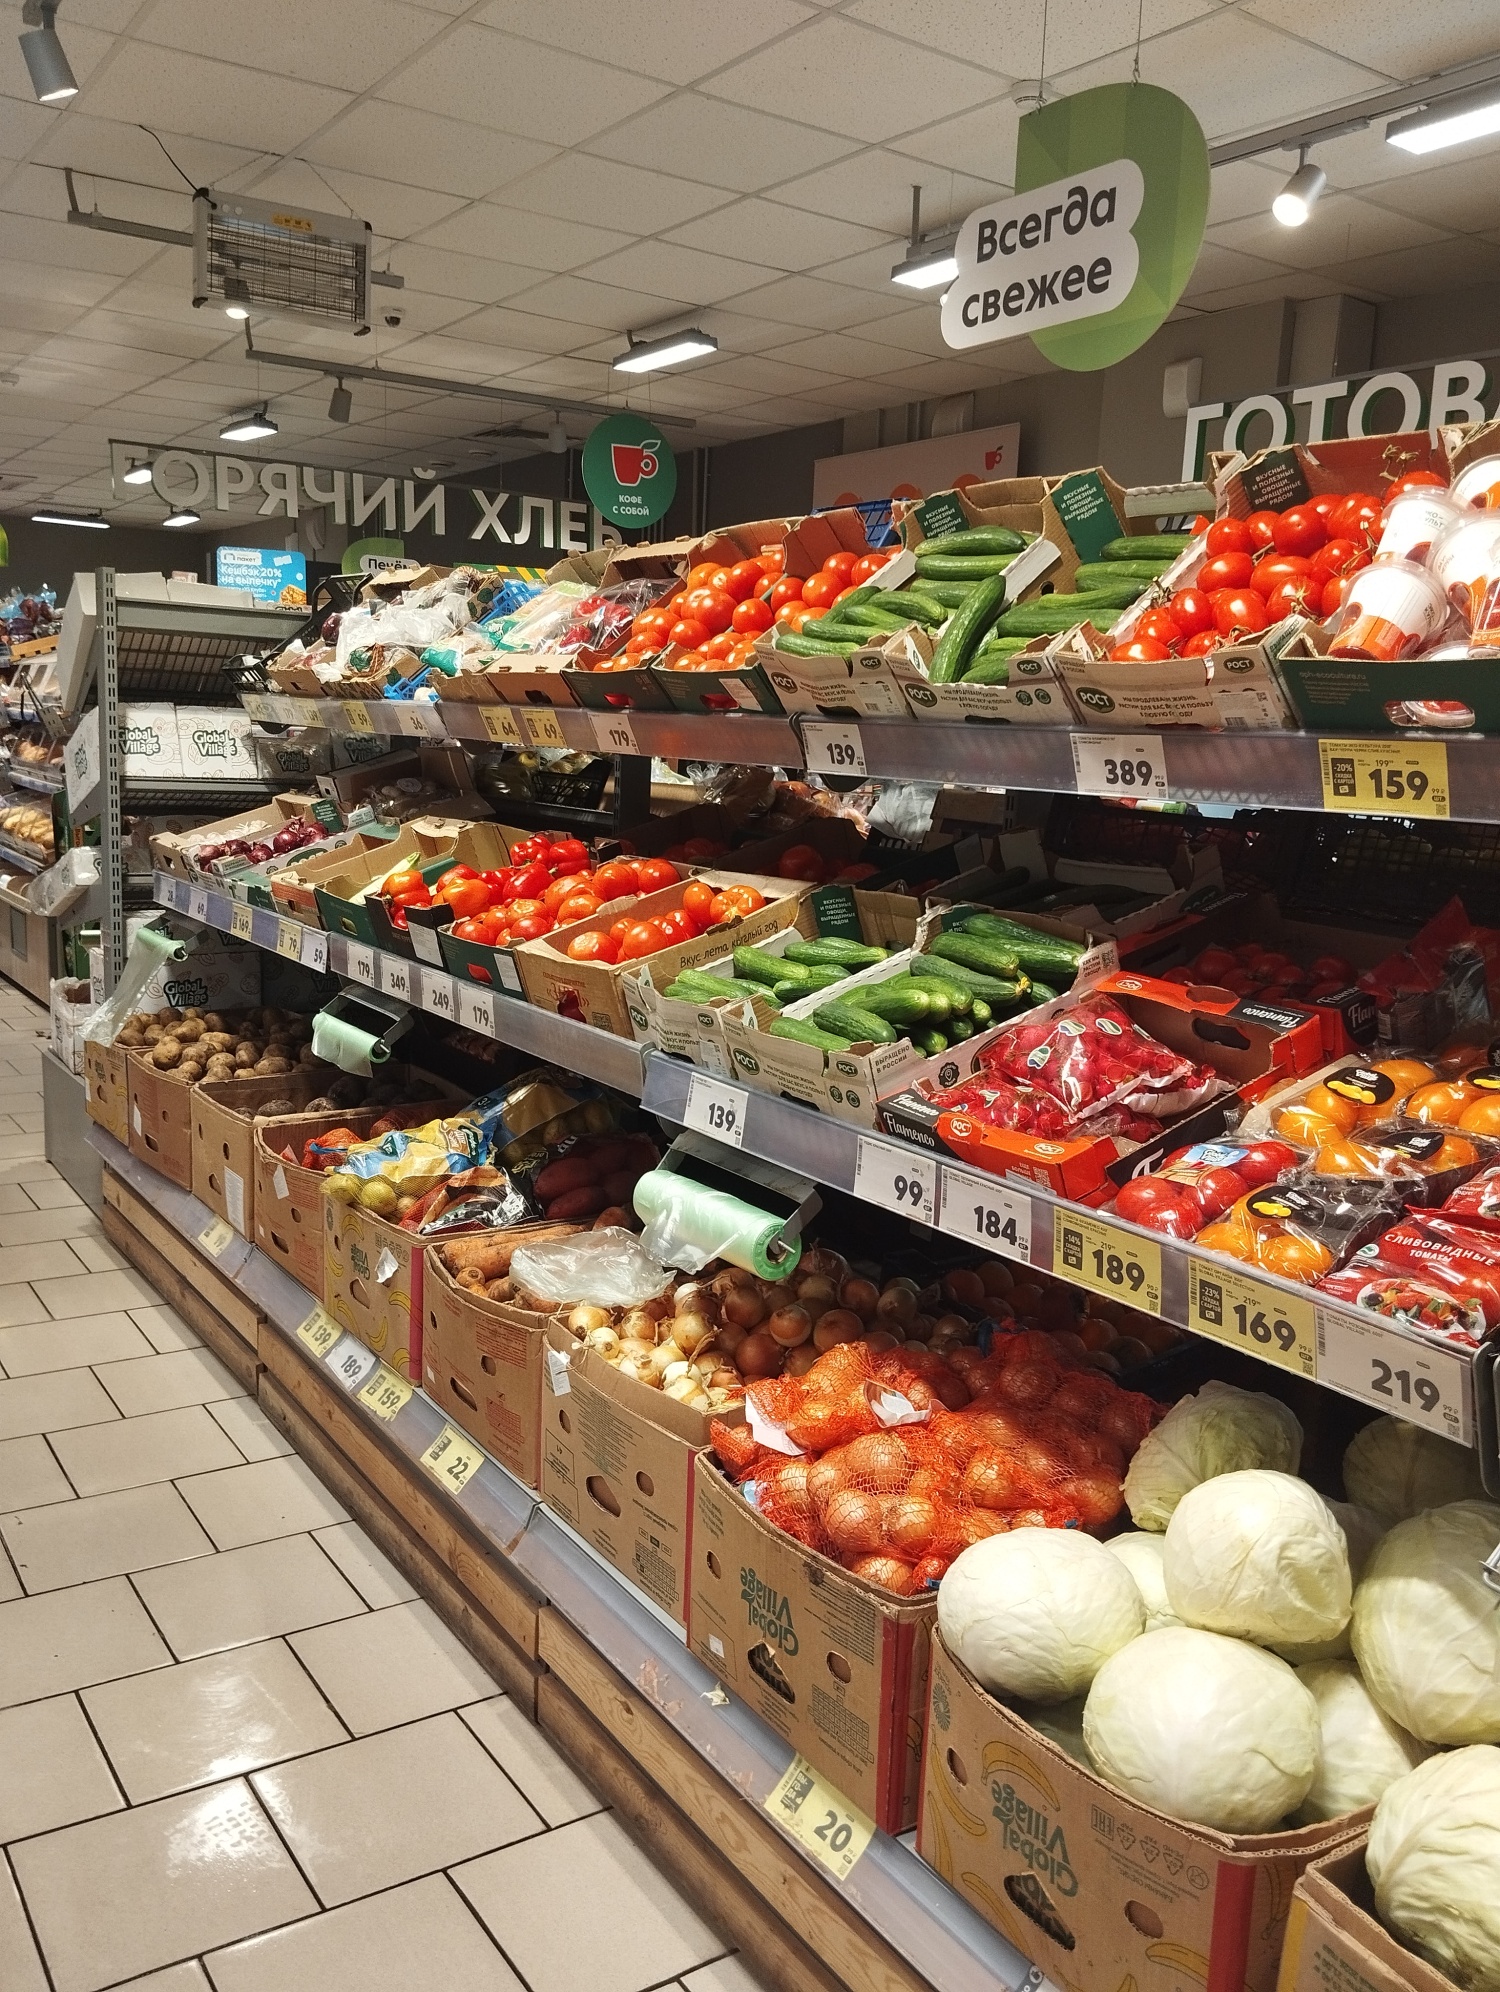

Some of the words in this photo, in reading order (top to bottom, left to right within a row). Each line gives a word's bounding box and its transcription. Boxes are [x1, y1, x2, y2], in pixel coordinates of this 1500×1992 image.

[976, 185, 1117, 264] Всегда
[961, 256, 1112, 328] свежее
[1180, 359, 1500, 483] ГОТОВ
[618, 494, 643, 504] КОФЕ
[612, 505, 619, 514] С
[620, 505, 650, 516] СОБОЙ
[221, 564, 260, 576] Кешбэк
[260, 566, 283, 578] 20%
[862, 658, 880, 667] РОСТ
[1020, 662, 1040, 672] РОСТ
[1226, 659, 1251, 670] РОСТ
[773, 675, 795, 688] РОСТ
[908, 688, 933, 701] РОСТ
[1079, 691, 1110, 707] РОСТ
[358, 712, 368, 726] 59
[410, 716, 423, 731] 36
[118, 727, 159, 744] Global
[501, 721, 516, 737] 64
[543, 723, 557, 740] 69
[608, 729, 631, 747] 179
[119, 740, 161, 755] Village
[193, 730, 236, 747] Global
[197, 742, 237, 757] Village
[826, 742, 855, 765] 139
[1104, 759, 1152, 786] 389
[1333, 764, 1353, 772] -20%
[1368, 768, 1429, 801] 159
[196, 902, 205, 915] 69
[238, 916, 249, 932] 169
[288, 936, 297, 953] 79
[680, 952, 702, 968] Вкус
[703, 944, 730, 959] лета
[764, 920, 779, 933] год
[313, 947, 323, 964] 59
[357, 959, 371, 979] 179
[165, 978, 208, 996] Global
[390, 972, 406, 992] 349
[168, 992, 209, 1007] Village
[432, 989, 450, 1011] 249
[472, 1005, 490, 1027] 179
[630, 1009, 646, 1026] РОСТ
[735, 1052, 756, 1070] РОСТ
[875, 1044, 911, 1067] ВЫРАЩЕНО
[882, 1053, 908, 1071] РОССИИ
[838, 1063, 856, 1074] РОСТ
[708, 1102, 736, 1132] 139
[883, 1111, 935, 1148] Flamenco
[894, 1174, 923, 1207] 99
[973, 1205, 1018, 1247] 184
[1065, 1234, 1081, 1246] -14%
[1100, 1241, 1112, 1251] 219
[1384, 1233, 1496, 1268] СЛИВОВИДНЫЕ
[1409, 1249, 1453, 1264] ТОМАТЫ
[1092, 1248, 1145, 1293] 189
[1198, 1269, 1215, 1278] GLOBAL
[1215, 1274, 1232, 1285] VILLAGE
[1201, 1286, 1220, 1299] -23%
[1243, 1296, 1257, 1306] 219
[1232, 1303, 1297, 1352] 169
[1299, 1343, 1308, 1352] 99
[1326, 1312, 1348, 1325] ТОМАТЫ
[1327, 1317, 1345, 1329] GLOBAL
[1345, 1325, 1365, 1337] VILLAGE
[311, 1324, 332, 1347] 139
[340, 1354, 362, 1379] 189
[1371, 1358, 1440, 1413] 219
[1443, 1404, 1452, 1413] 99
[377, 1387, 402, 1410] 159
[446, 1456, 469, 1482] 22
[740, 1566, 796, 1631] Village
[745, 1602, 799, 1657] Global
[813, 1809, 853, 1853] 20
[991, 1779, 1071, 1866] Village
[1002, 1822, 1079, 1897] Global
